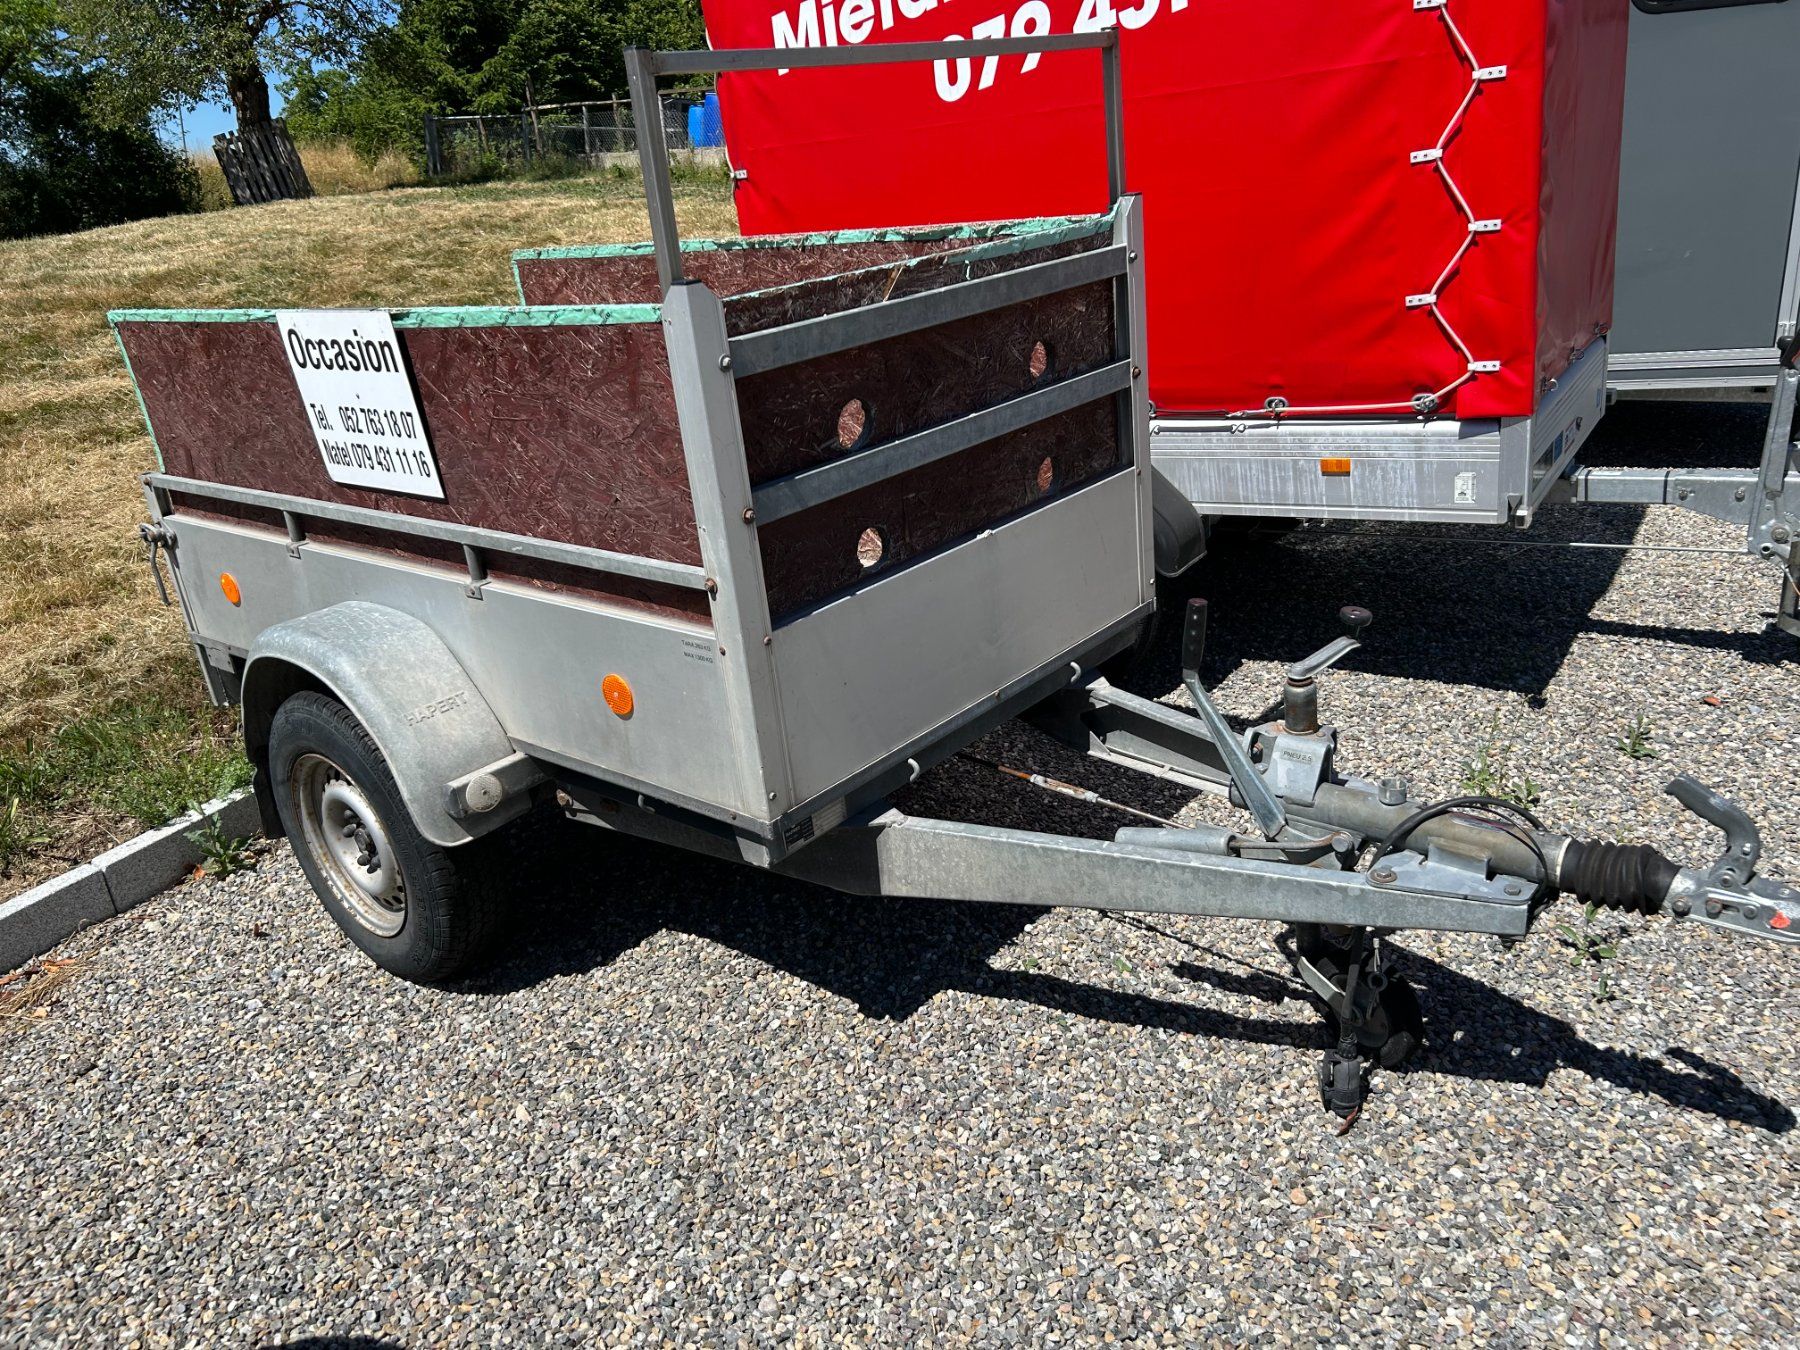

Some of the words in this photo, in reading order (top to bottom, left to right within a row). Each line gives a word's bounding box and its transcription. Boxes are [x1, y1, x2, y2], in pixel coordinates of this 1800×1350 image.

[933, 0, 1051, 102] 079
[287, 328, 400, 373] Occasion
[309, 403, 334, 431] Tel.
[338, 406, 364, 434] 052
[359, 408, 385, 436] 763
[383, 410, 401, 438] 18
[400, 411, 417, 439] 07
[321, 438, 354, 467] Natel
[351, 443, 374, 471] 079
[374, 444, 396, 473] 431
[395, 448, 413, 475] 11
[412, 449, 431, 478] 16
